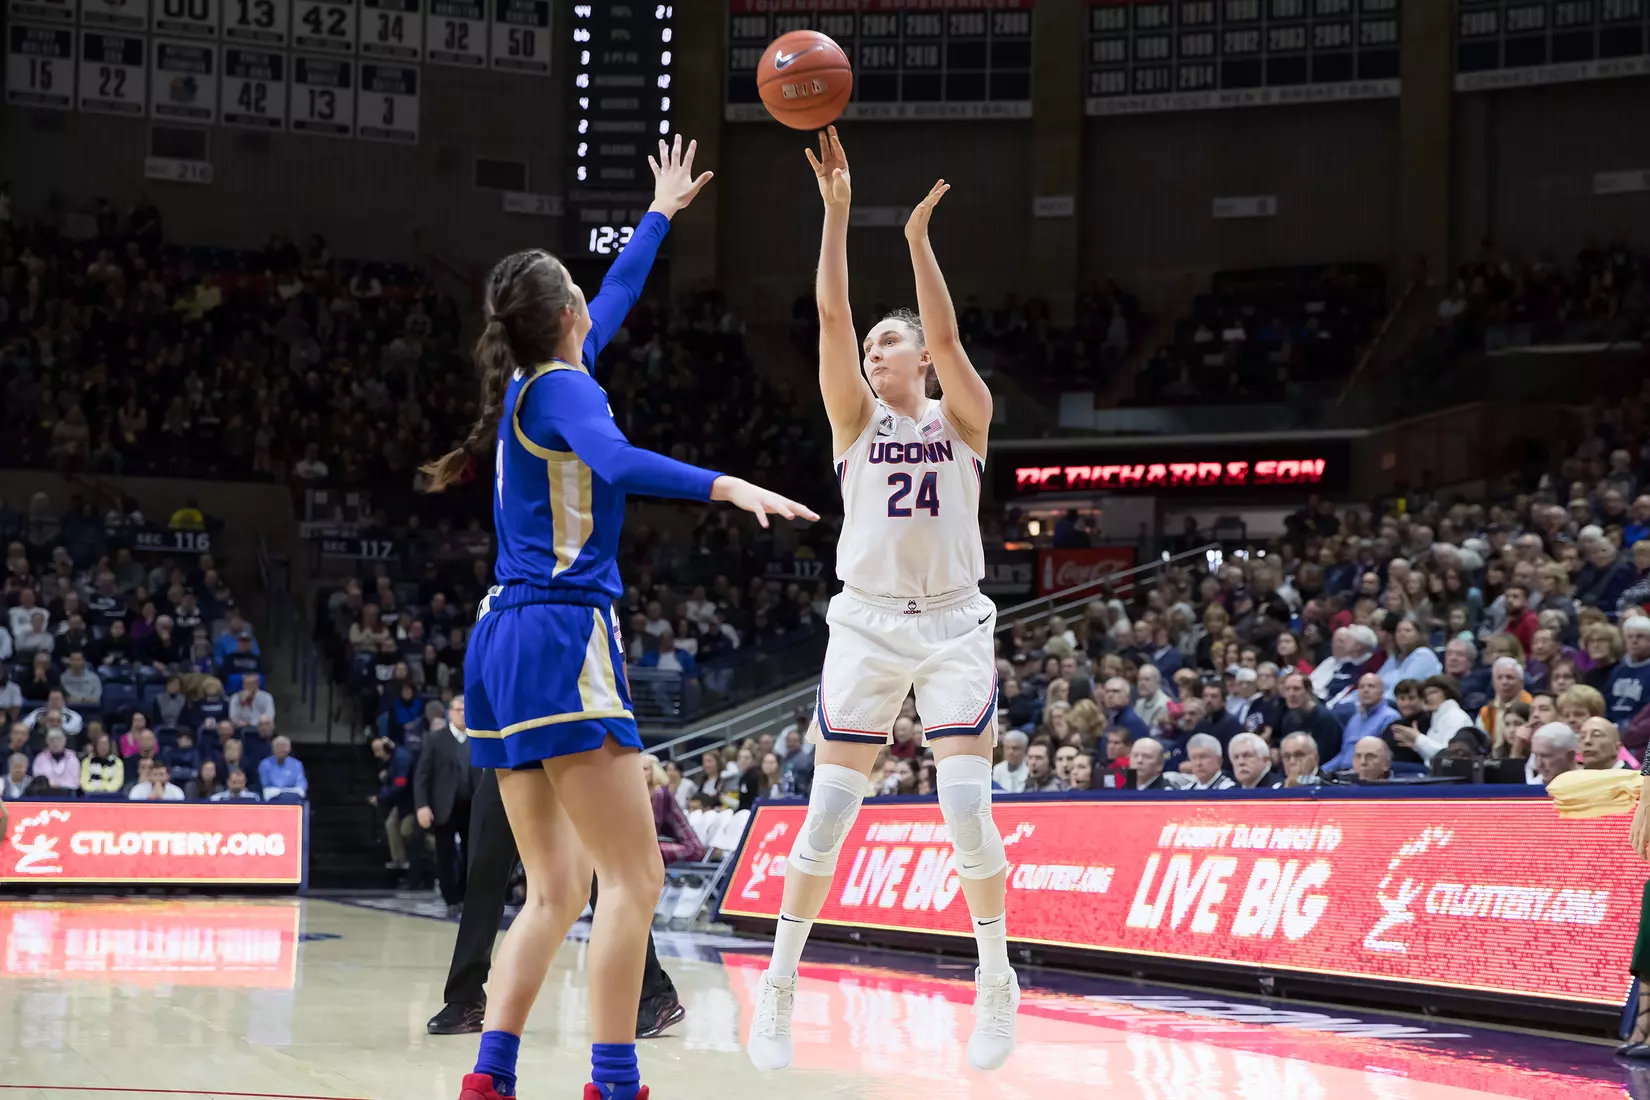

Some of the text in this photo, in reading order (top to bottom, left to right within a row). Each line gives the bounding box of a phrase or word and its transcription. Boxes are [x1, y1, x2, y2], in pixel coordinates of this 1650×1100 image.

[236, 0, 275, 28] 13
[302, 6, 347, 37] 42
[377, 13, 404, 44] 34
[445, 21, 468, 50] 32
[508, 28, 535, 57] 50
[29, 58, 53, 90] 15
[99, 66, 127, 98] 22
[237, 82, 268, 114] 42
[309, 89, 336, 120] 13
[383, 96, 395, 126] 3
[868, 440, 954, 465] UCONN
[1252, 458, 1327, 487] SON
[887, 471, 940, 518] 24
[136, 532, 210, 552] SEC 116
[360, 540, 394, 558] 117
[793, 560, 824, 578] 117
[69, 831, 286, 856] CTLOTTERY.ORG
[839, 846, 913, 909] LIVE
[1126, 853, 1332, 941] LIVE BIG
